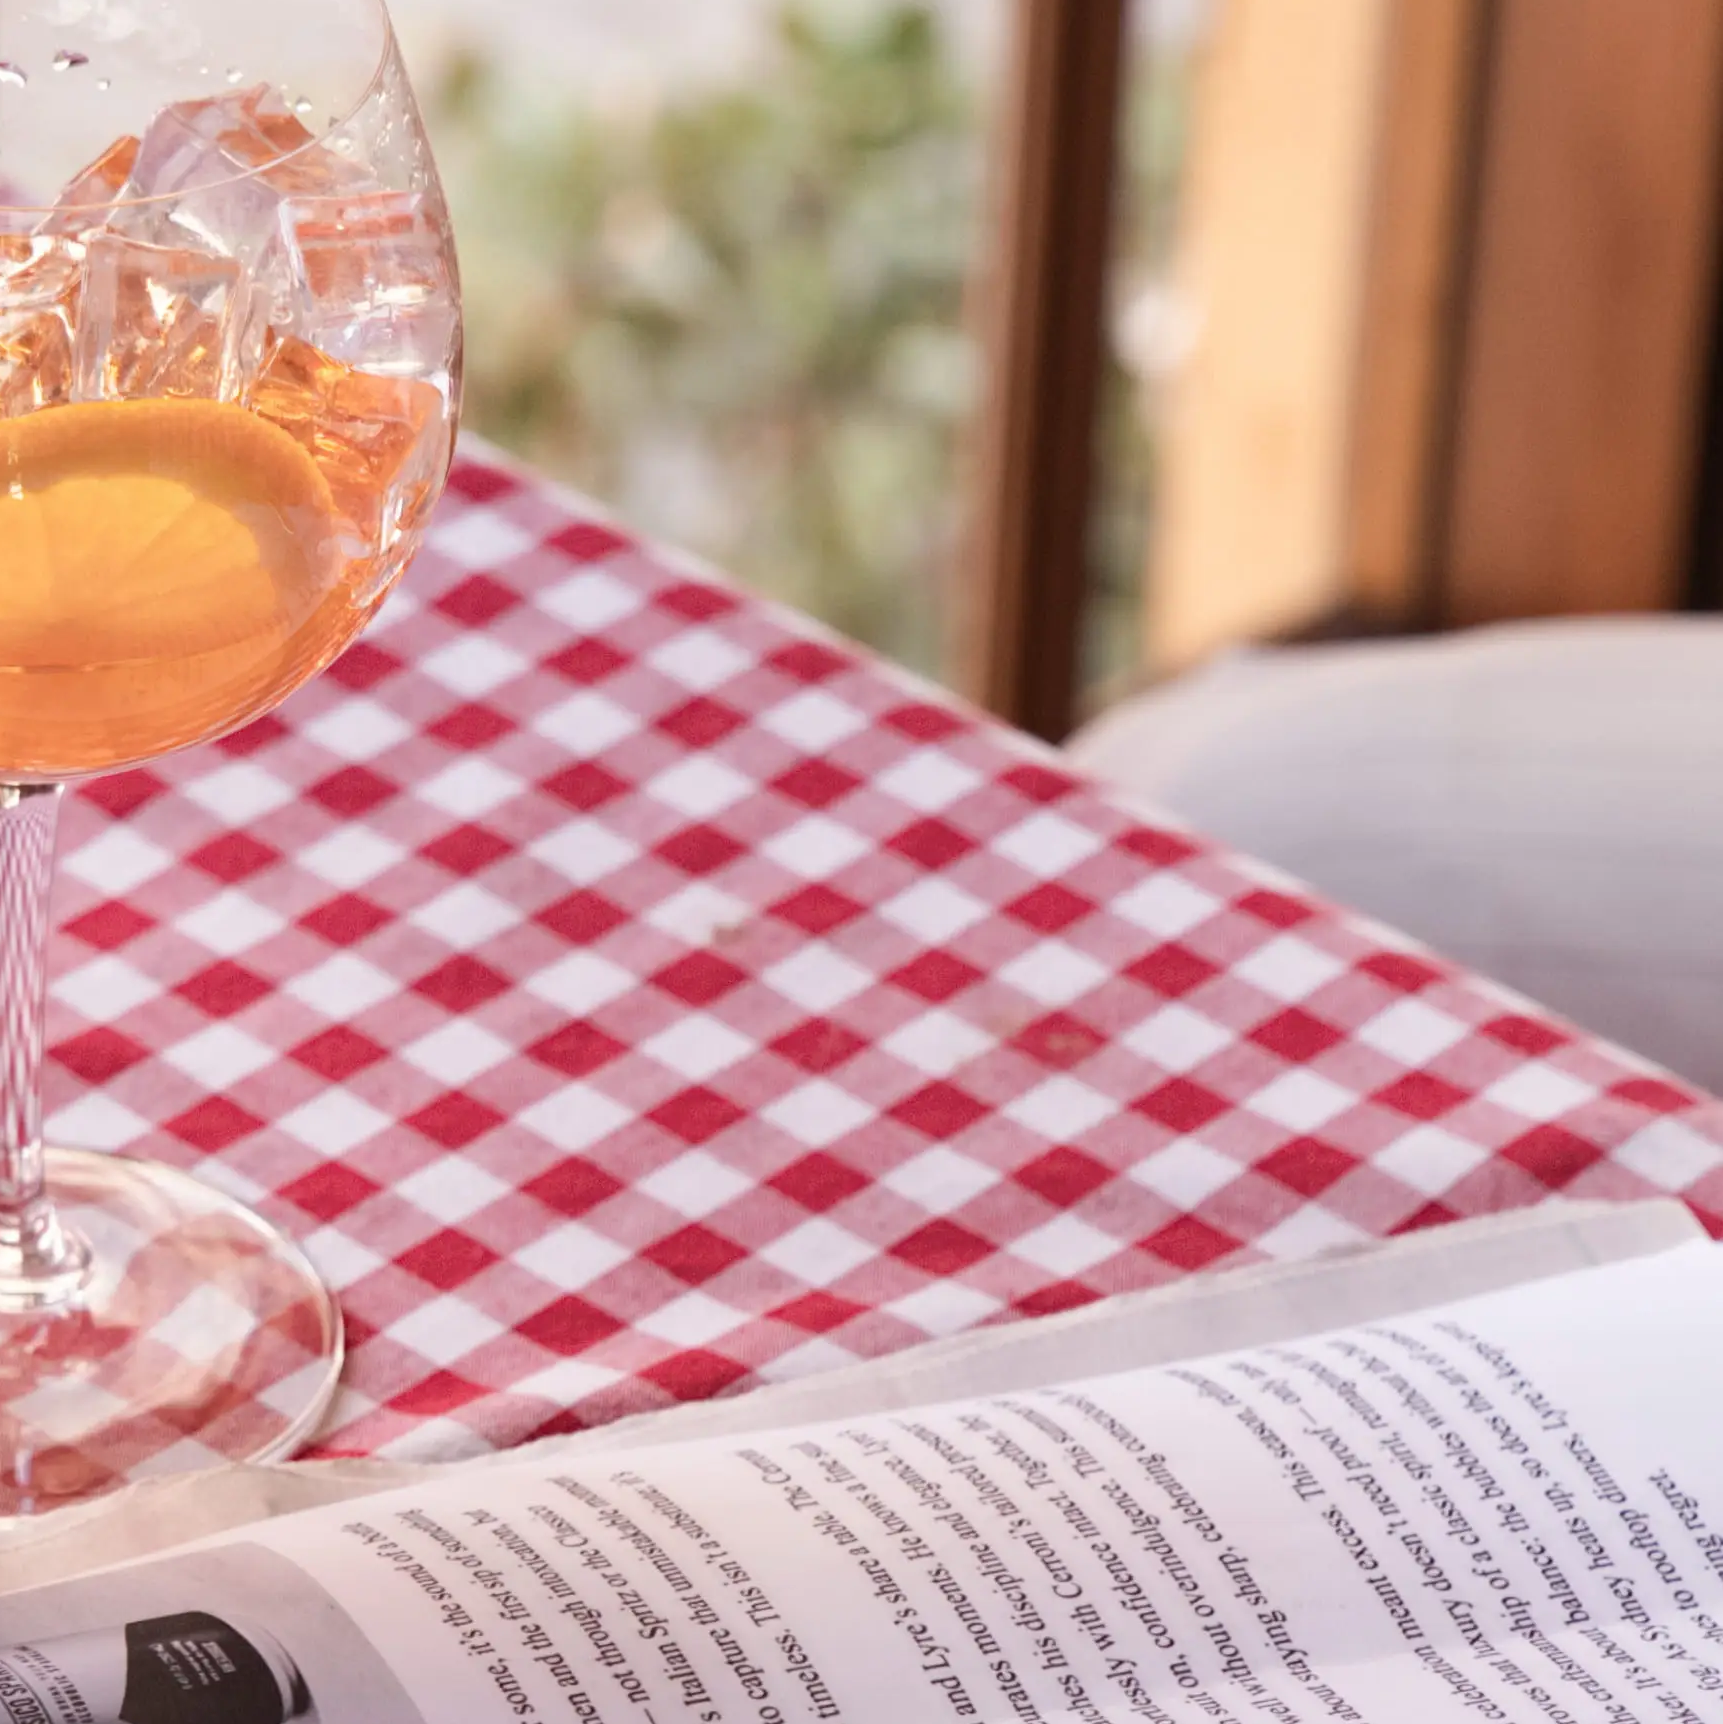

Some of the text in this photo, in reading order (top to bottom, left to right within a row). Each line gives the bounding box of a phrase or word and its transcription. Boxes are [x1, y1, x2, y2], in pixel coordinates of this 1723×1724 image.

[855, 1493, 914, 1537] knows
[933, 1511, 981, 1541] and
[1046, 1489, 1102, 1540] intact.
[1136, 1452, 1225, 1544] celebrating
[1438, 1430, 1592, 1627] balance: bubbles
[1647, 1467, 1707, 1532] regret.
[490, 1522, 577, 1599] intoxication,
[1100, 1477, 1217, 1619] overindulgence.
[1217, 1545, 1269, 1607] sharp,
[1344, 1472, 1503, 1660] luxury doesn't need
[1378, 1430, 1615, 1703] craftsmanship classic spirit,
[1564, 1515, 1671, 1643] Sydney heats
[1618, 1508, 1684, 1586] rooftop
[393, 1562, 453, 1602] sound
[488, 1589, 532, 1622] first
[679, 1593, 721, 1627] that
[739, 1585, 782, 1629] This
[857, 1557, 909, 1605] share
[926, 1561, 1002, 1657] moments.
[968, 1542, 1047, 1633] discipline
[1089, 1541, 1177, 1650] confidence
[1320, 1503, 1508, 1720] celebration meant excess.
[439, 1602, 475, 1629] the
[458, 1628, 497, 1657] it's
[519, 1622, 555, 1652] the
[558, 1599, 628, 1669] through
[615, 1588, 670, 1640] Spritz
[892, 1606, 952, 1673] Lyre's
[1068, 1602, 1117, 1653] with
[1255, 1609, 1320, 1683] staying
[532, 1651, 581, 1688] and
[656, 1640, 713, 1708] Italian
[708, 1627, 770, 1701] capture
[774, 1628, 842, 1721] timeless.
[1034, 1635, 1071, 1671] his
[1201, 1621, 1269, 1697] without
[486, 1657, 536, 1716] some,
[610, 1668, 652, 1705] not
[929, 1674, 978, 1717] and
